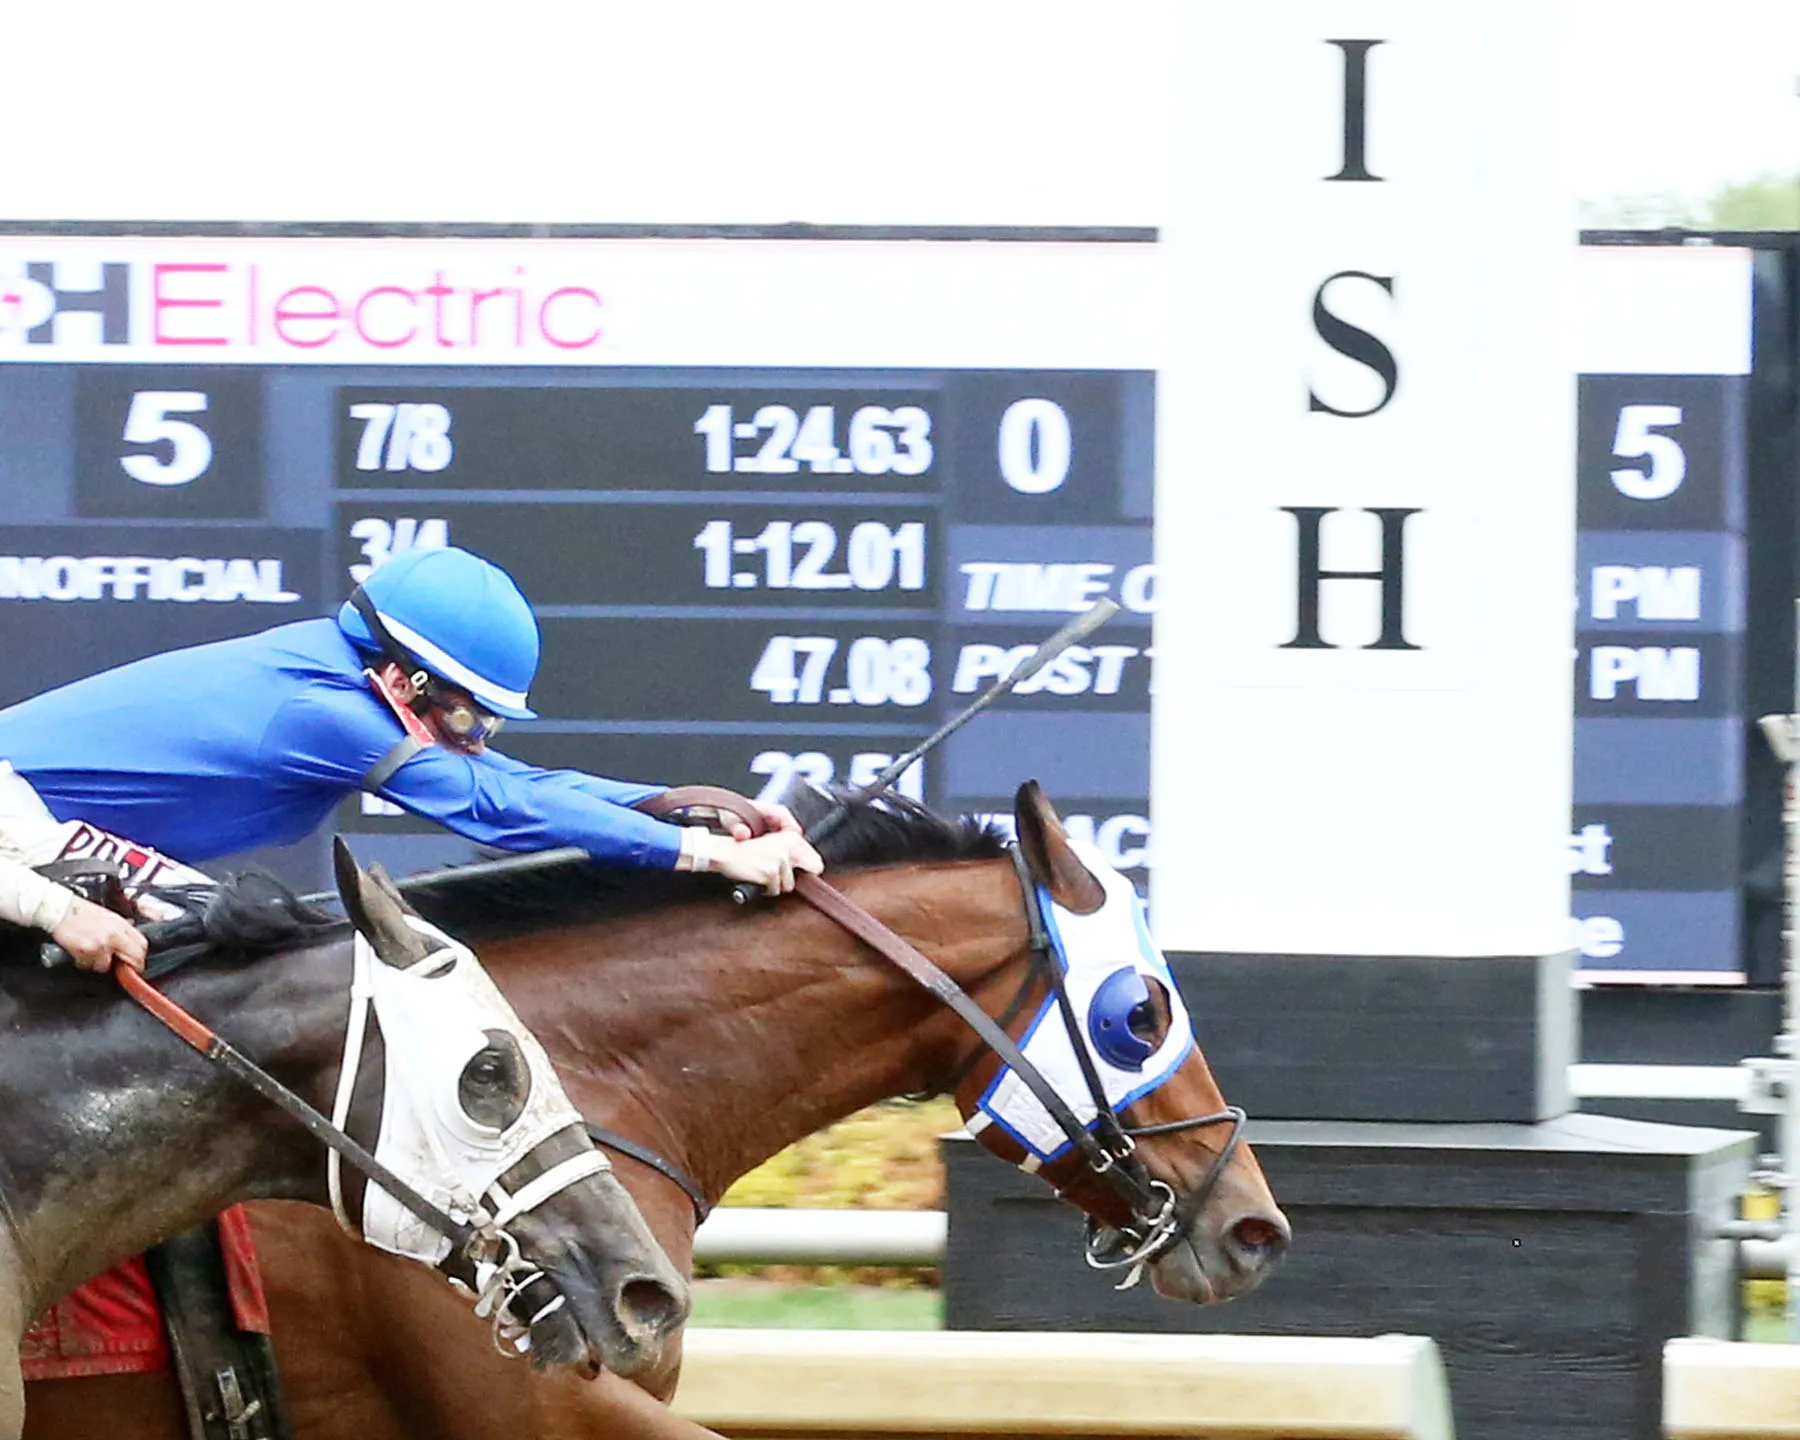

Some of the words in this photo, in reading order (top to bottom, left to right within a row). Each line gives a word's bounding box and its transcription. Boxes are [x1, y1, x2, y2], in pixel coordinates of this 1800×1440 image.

[153, 263, 603, 349] Electric
[119, 391, 212, 486] 5
[349, 403, 453, 472] 7/8
[693, 404, 934, 475] 1:24.63
[998, 397, 1073, 494] 0
[1609, 403, 1687, 500] 5
[693, 520, 926, 590] 1:12.01
[960, 562, 1115, 611] TIME
[1590, 566, 1701, 621] PM
[749, 635, 932, 706] 47.08
[951, 643, 1139, 695] POST
[1589, 646, 1701, 701] PM
